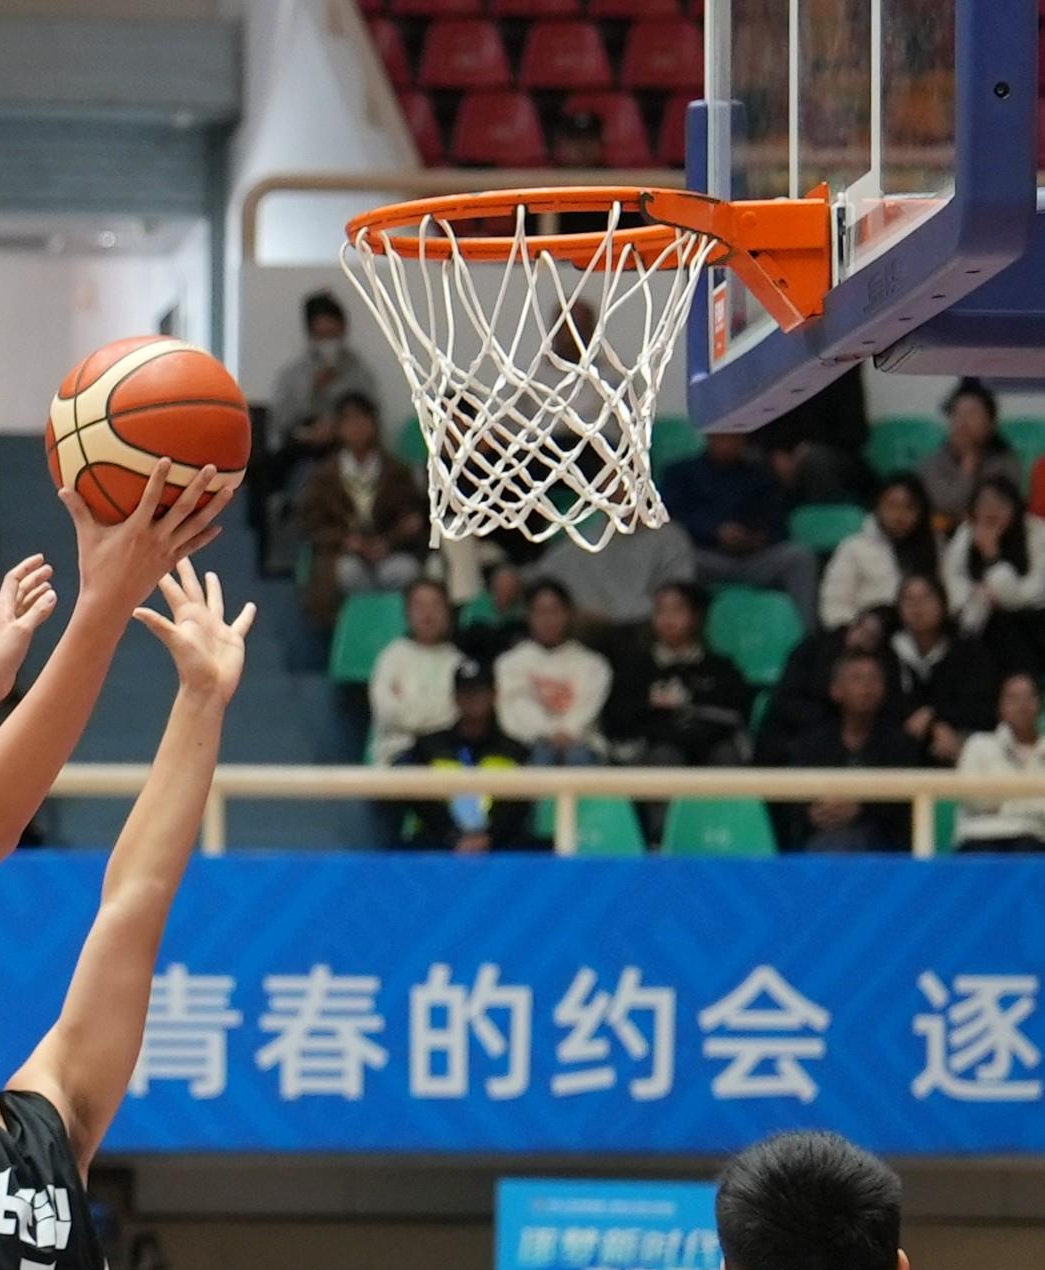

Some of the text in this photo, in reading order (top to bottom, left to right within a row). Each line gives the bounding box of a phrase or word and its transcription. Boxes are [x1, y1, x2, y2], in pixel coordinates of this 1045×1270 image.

[128, 962, 1042, 1101] 青春的约会 逐
